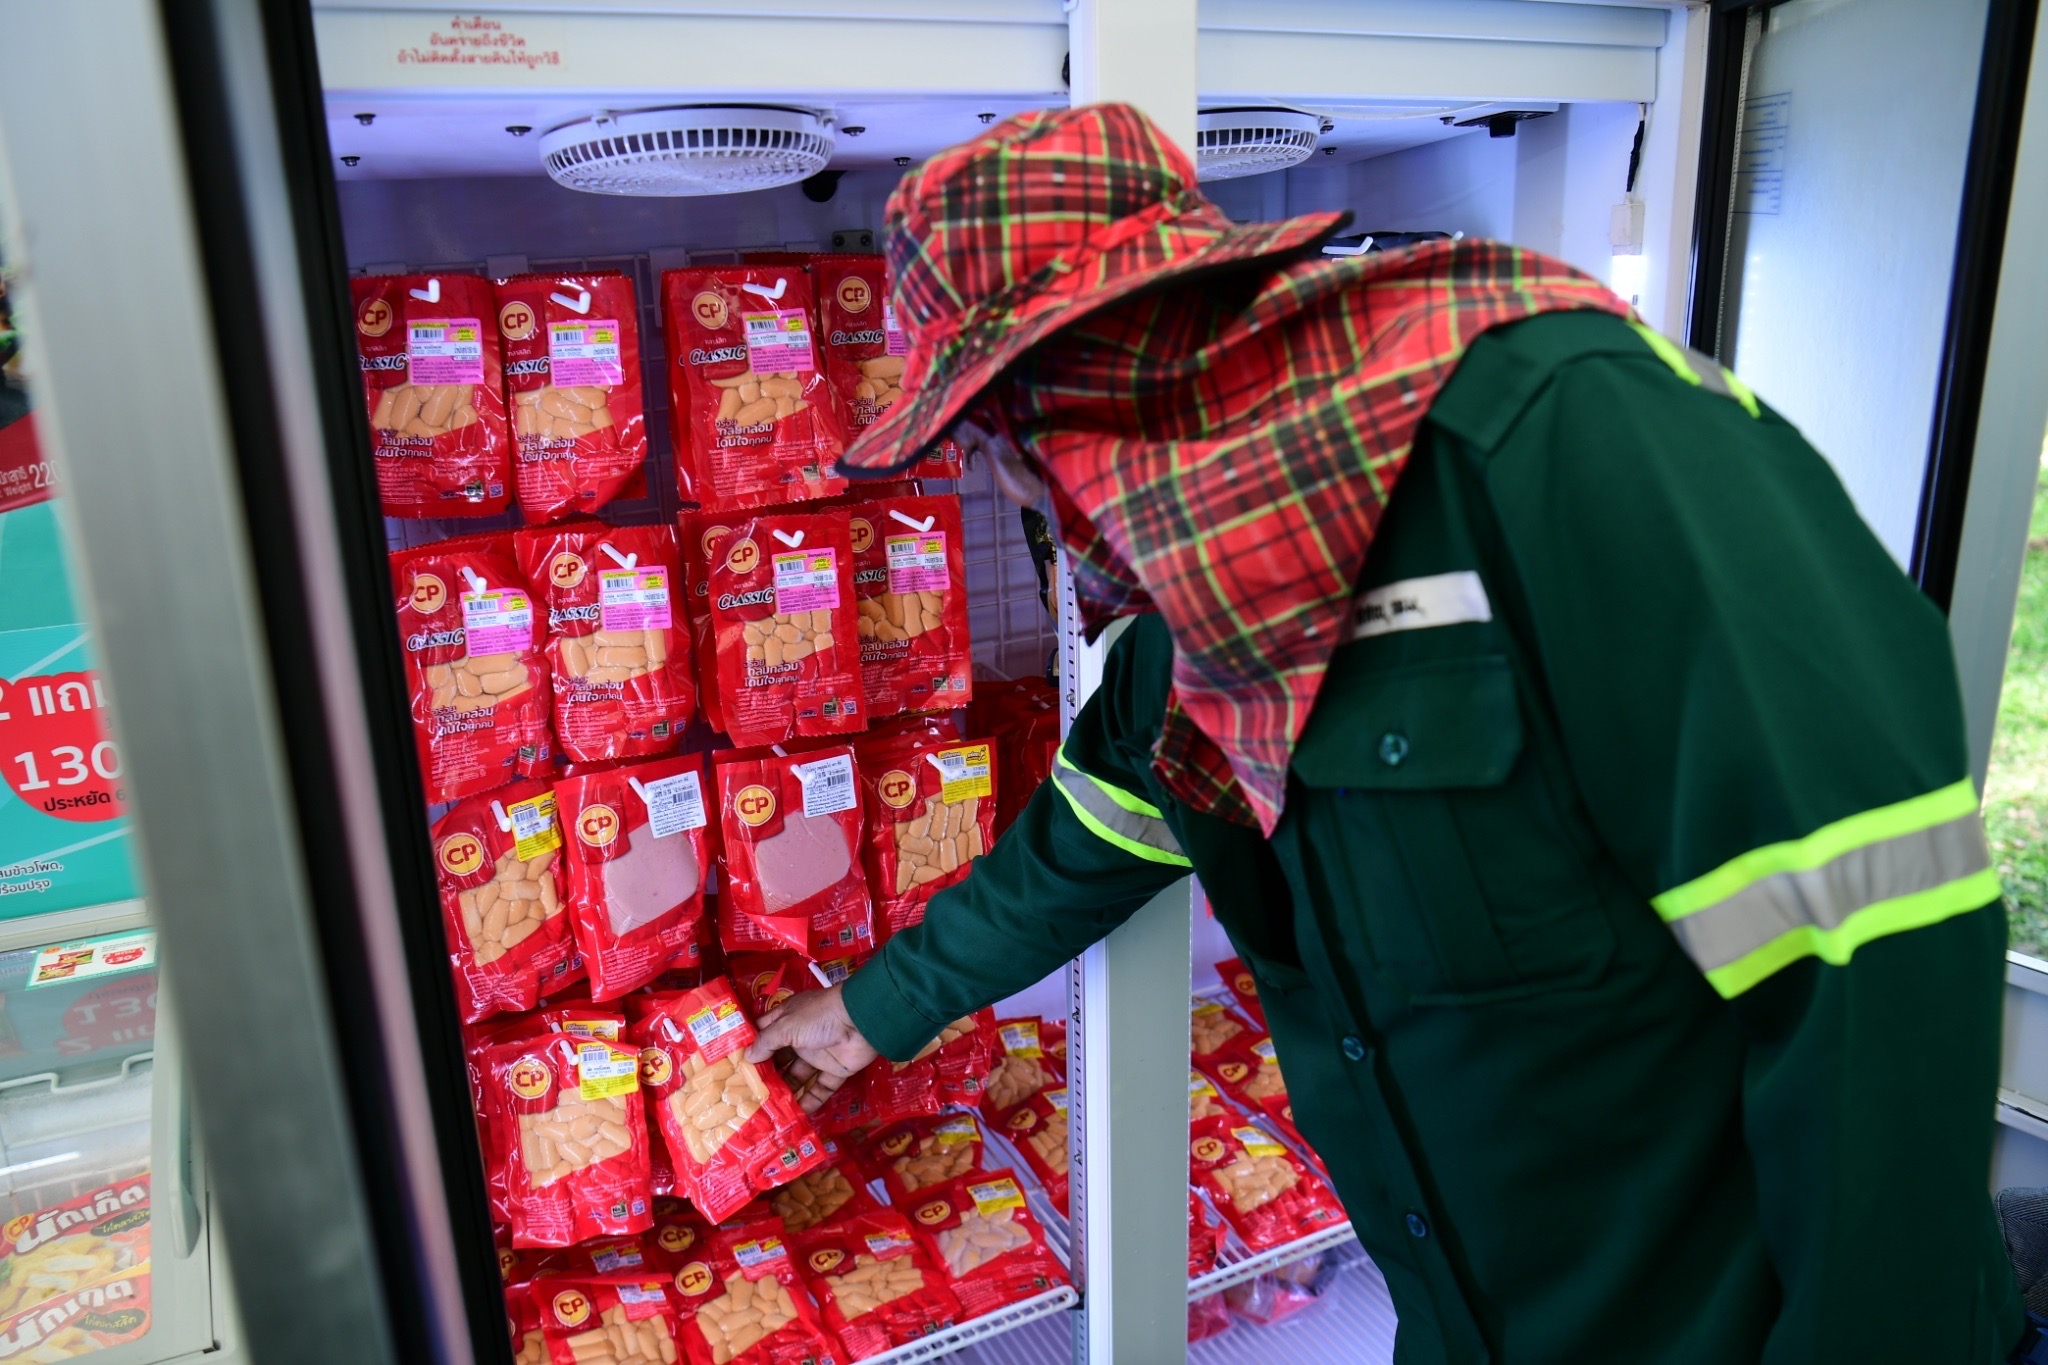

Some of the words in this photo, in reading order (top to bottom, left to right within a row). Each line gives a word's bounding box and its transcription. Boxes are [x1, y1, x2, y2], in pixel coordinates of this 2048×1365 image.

[840, 287, 865, 303] CP
[362, 306, 387, 326] CP
[697, 301, 721, 318] CP
[504, 313, 528, 331] CP
[830, 329, 884, 345] CLASSIC
[690, 344, 746, 366] CLASSIC
[505, 356, 550, 375] ASSIC
[731, 547, 753, 563] CP
[554, 561, 578, 579] CP
[416, 585, 439, 602] CP
[718, 587, 775, 610] CLASSIC
[860, 651, 908, 661] ดนใจทุกคน
[14, 740, 125, 791] 130
[883, 780, 910, 798] CP
[44, 790, 111, 812] ประหยัด
[740, 797, 769, 815] CP
[583, 816, 612, 836] CP
[446, 843, 477, 866] CP
[641, 1058, 664, 1078] CP
[515, 1070, 545, 1087] CP
[16, 1185, 146, 1253] นักเก็ต
[920, 1204, 946, 1219] CP
[10, 1216, 29, 1238] CP
[663, 1231, 689, 1243] CP
[813, 1252, 841, 1266] CP
[681, 1271, 706, 1288] CP
[559, 1297, 585, 1316] CP
